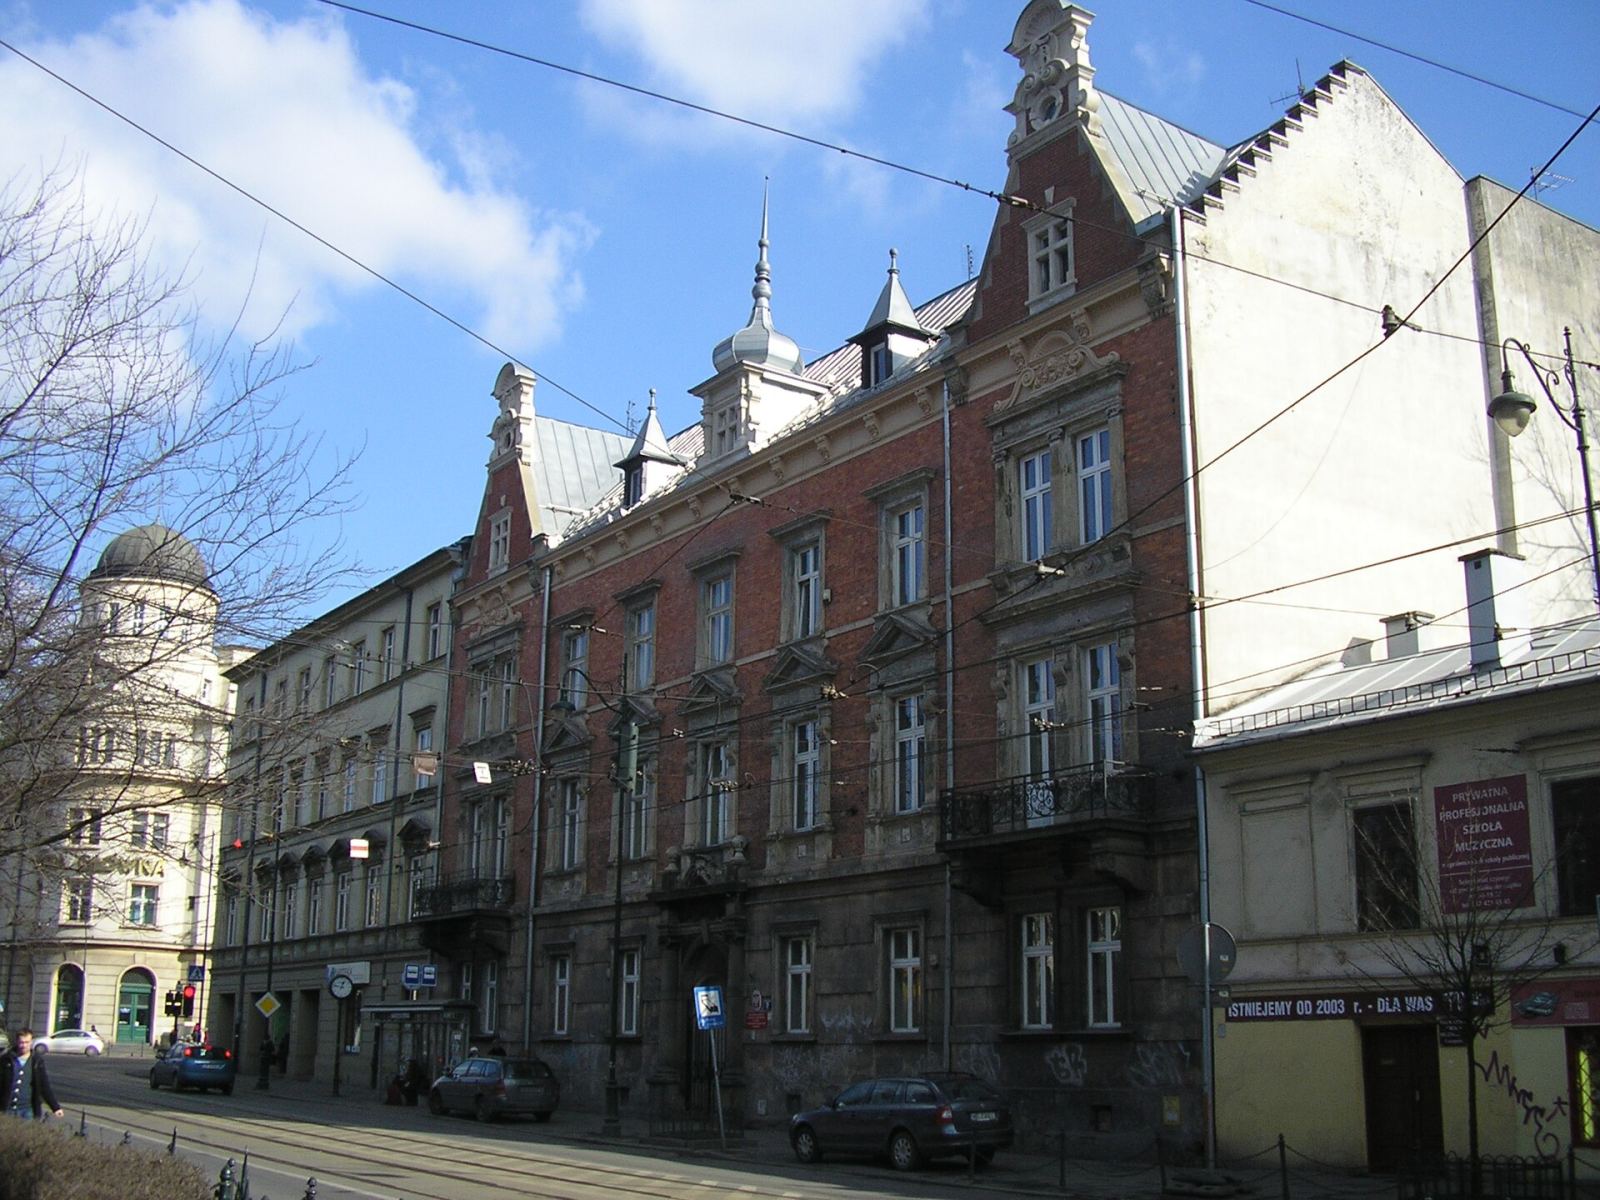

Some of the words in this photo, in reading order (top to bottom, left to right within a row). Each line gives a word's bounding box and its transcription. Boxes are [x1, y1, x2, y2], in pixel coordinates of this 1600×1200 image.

[1452, 786, 1508, 803] PRYWATNA
[1439, 801, 1525, 822] PROFESJONALNA
[1462, 821, 1503, 835] SZKOŁA
[1455, 837, 1513, 853] MUZYCZNA
[1228, 1001, 1293, 1017] ISTNIEJEMY
[1296, 1000, 1312, 1015] OD
[1316, 999, 1345, 1015] 2003
[1353, 1001, 1363, 1013] r.
[1377, 997, 1401, 1013] DLA
[1405, 995, 1434, 1012] WAS
